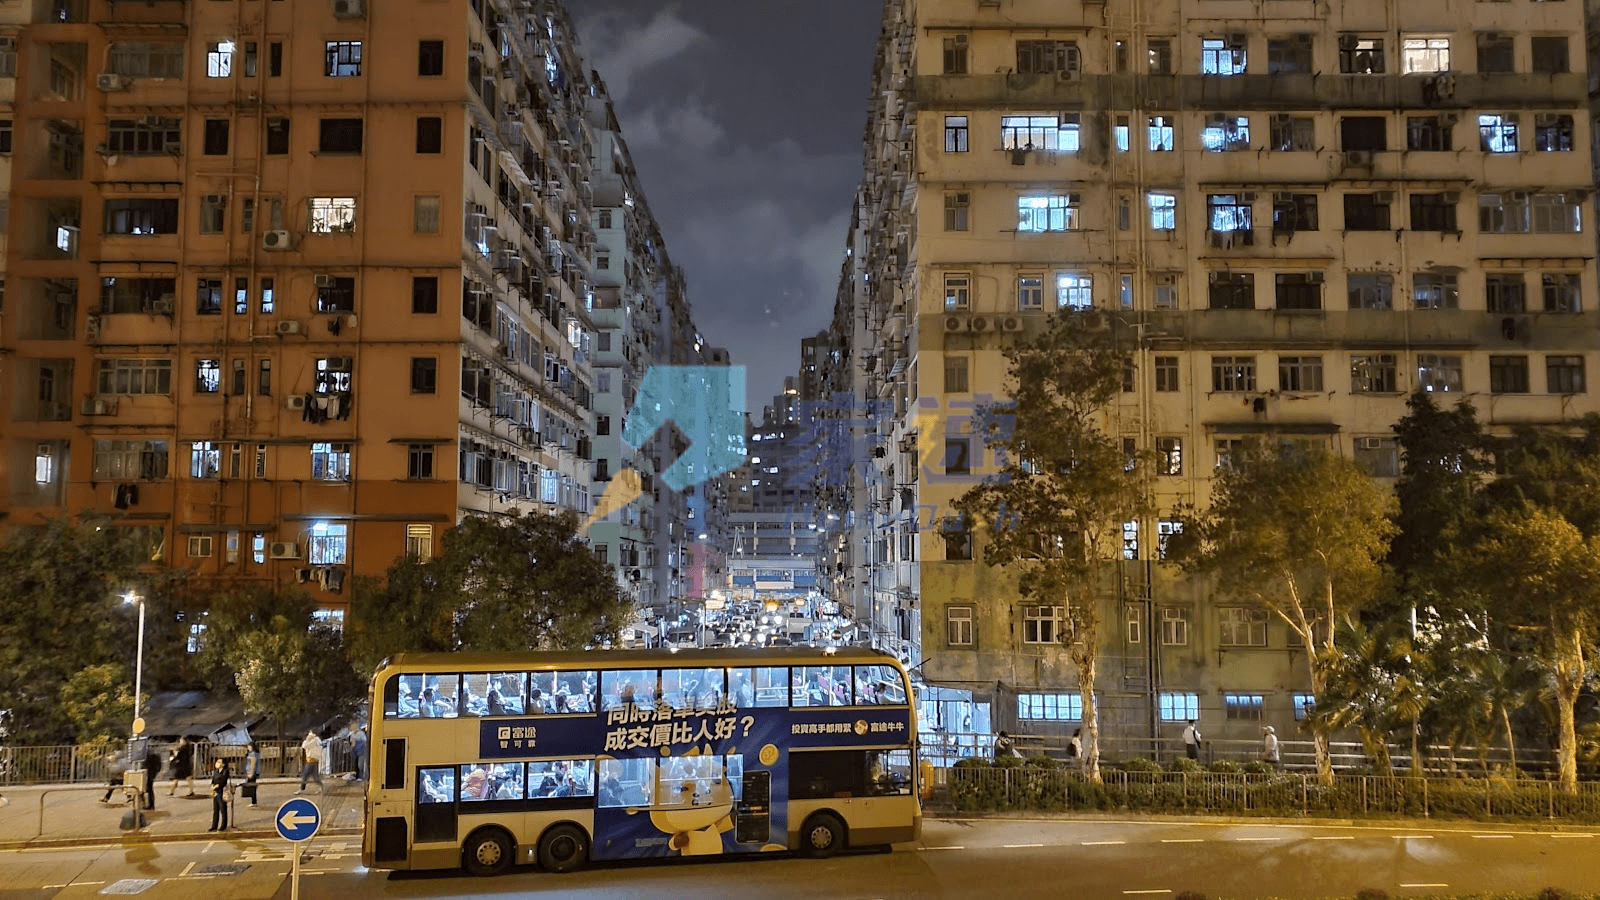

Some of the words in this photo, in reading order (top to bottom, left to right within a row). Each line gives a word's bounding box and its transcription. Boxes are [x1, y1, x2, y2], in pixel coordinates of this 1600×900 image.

[604, 715, 755, 752] 成交價比人好？
